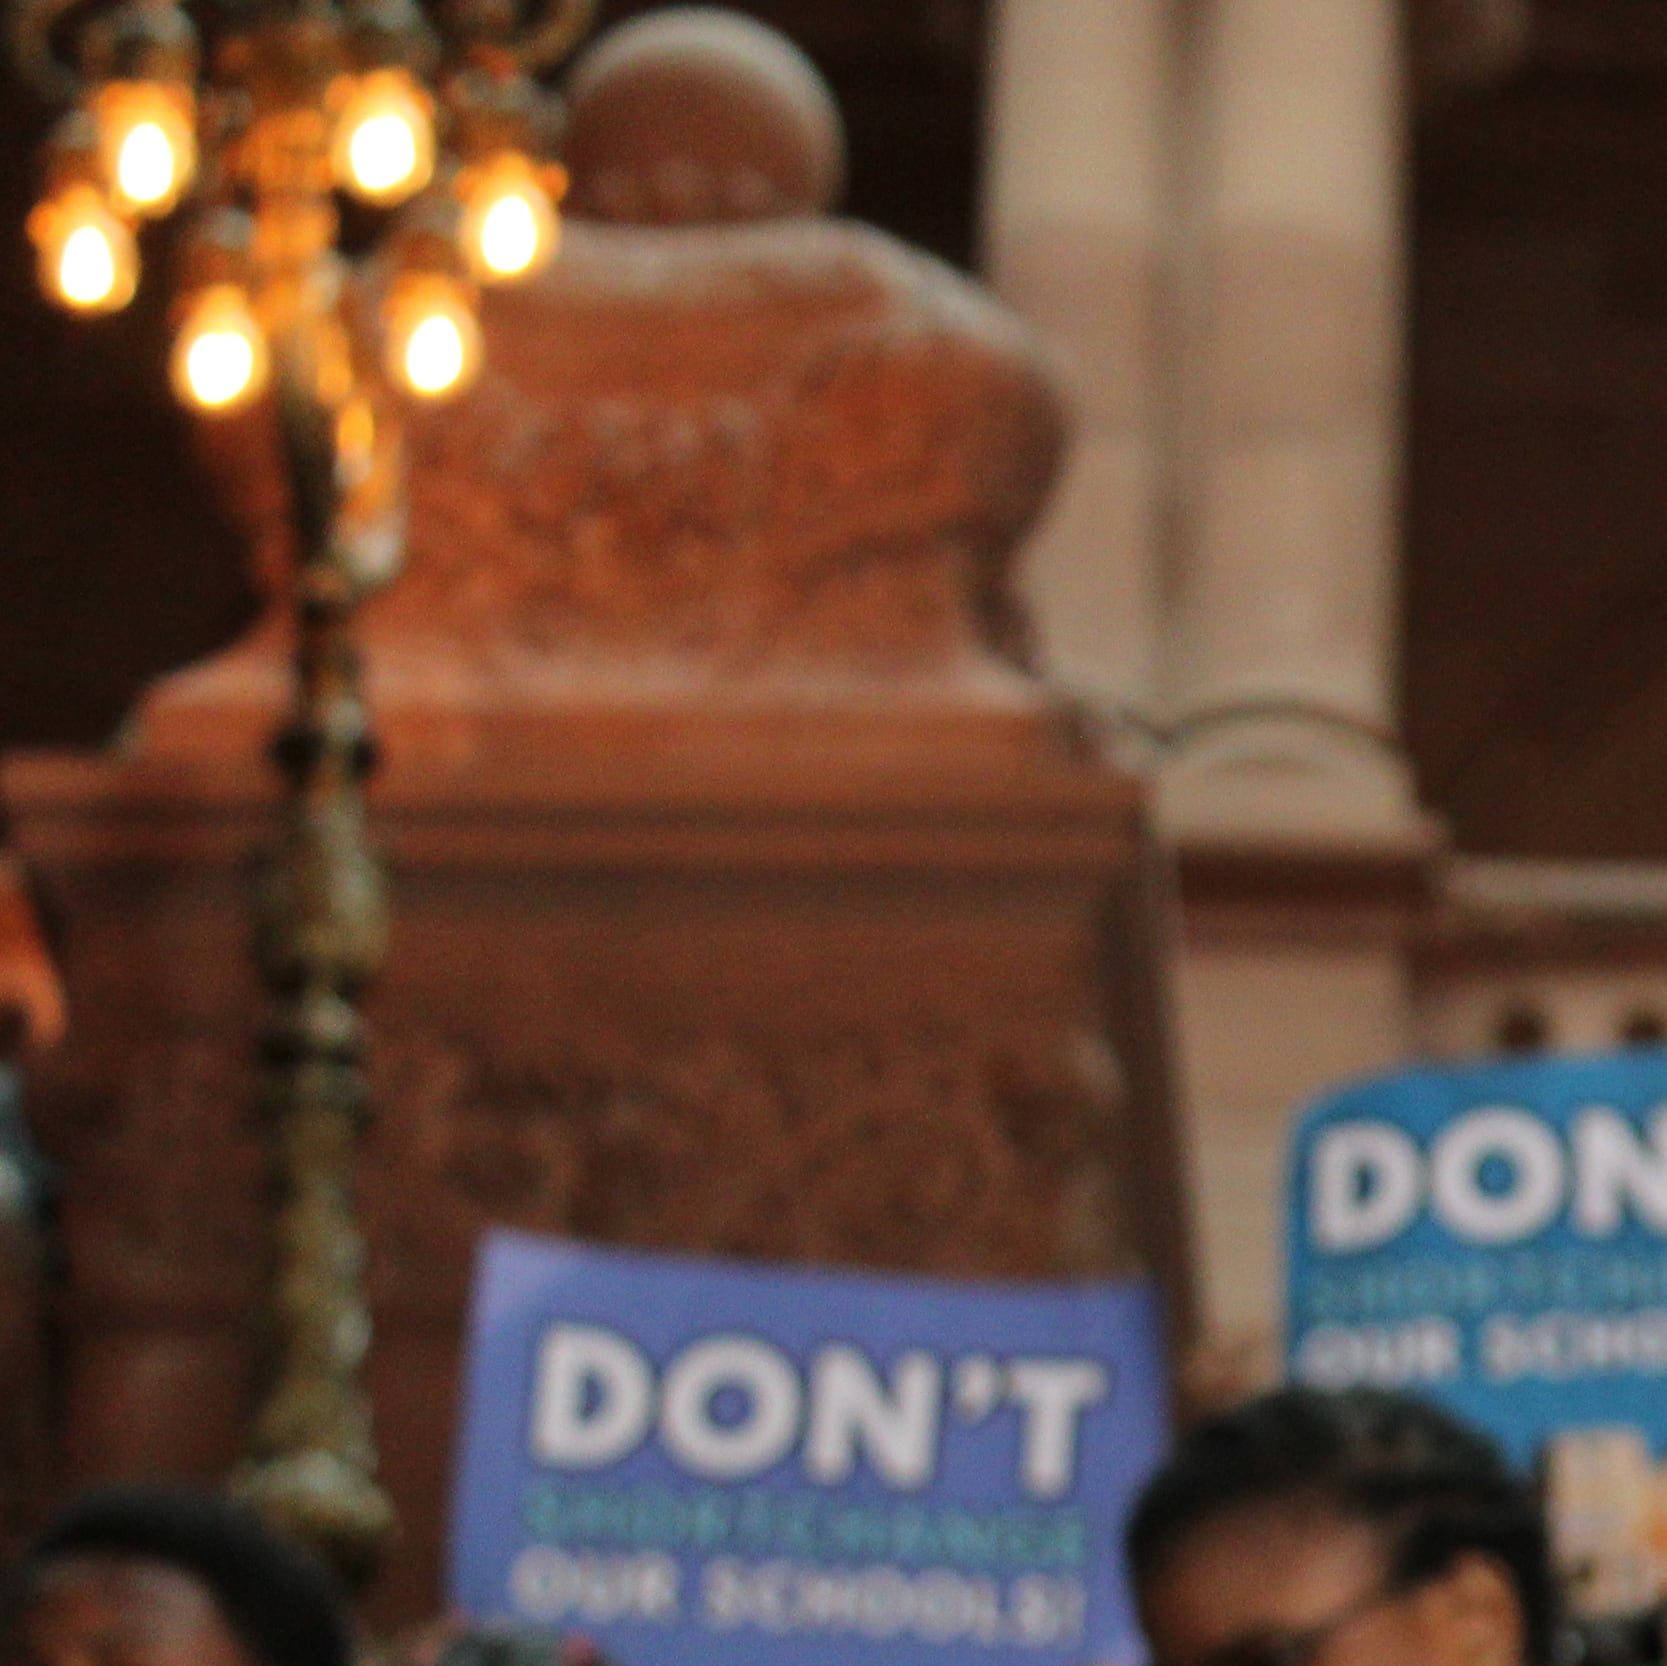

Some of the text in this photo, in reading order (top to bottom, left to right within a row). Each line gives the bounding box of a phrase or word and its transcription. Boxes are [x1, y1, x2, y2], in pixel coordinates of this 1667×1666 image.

[1297, 1314, 1462, 1390] OUR
[530, 1318, 1110, 1497] DON'T
[510, 1544, 680, 1620] OUR
